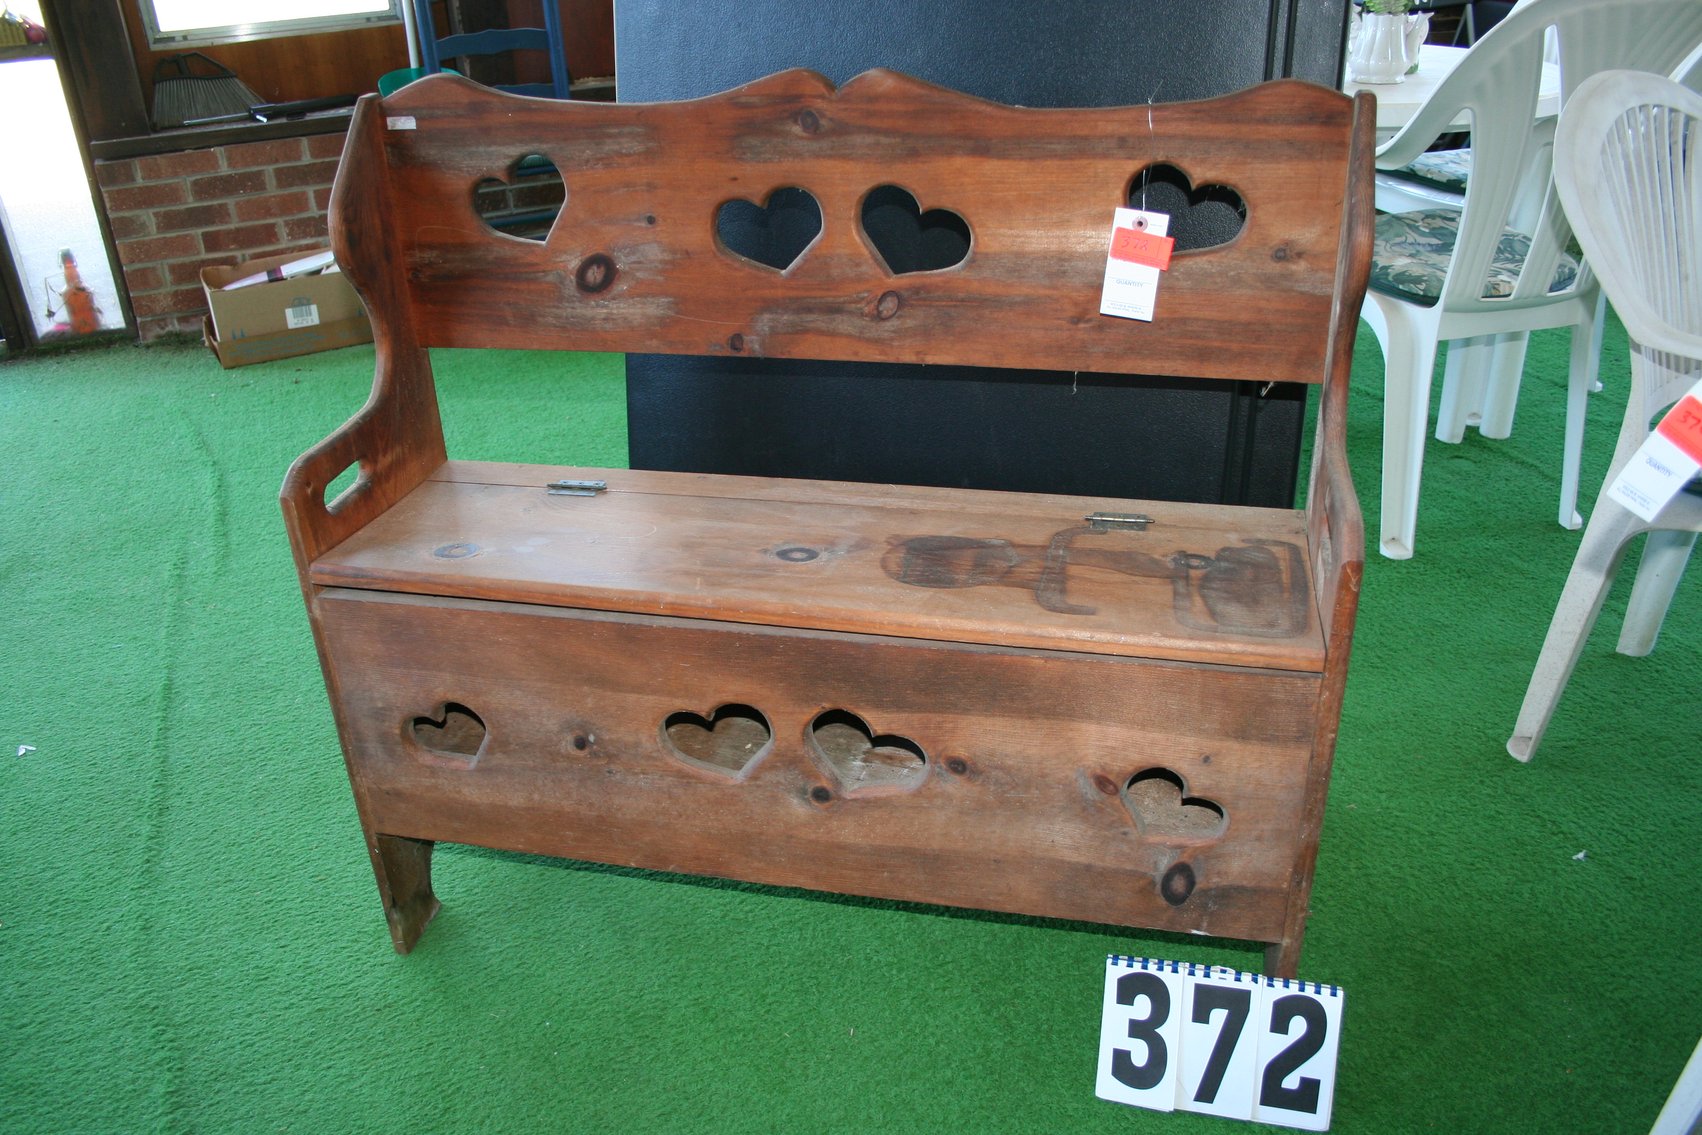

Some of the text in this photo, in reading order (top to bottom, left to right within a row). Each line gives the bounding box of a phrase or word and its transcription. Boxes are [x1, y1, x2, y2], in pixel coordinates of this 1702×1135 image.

[1115, 278, 1144, 288] QUANTITY
[1678, 410, 1702, 435] 37
[1111, 971, 1328, 1114] 372
